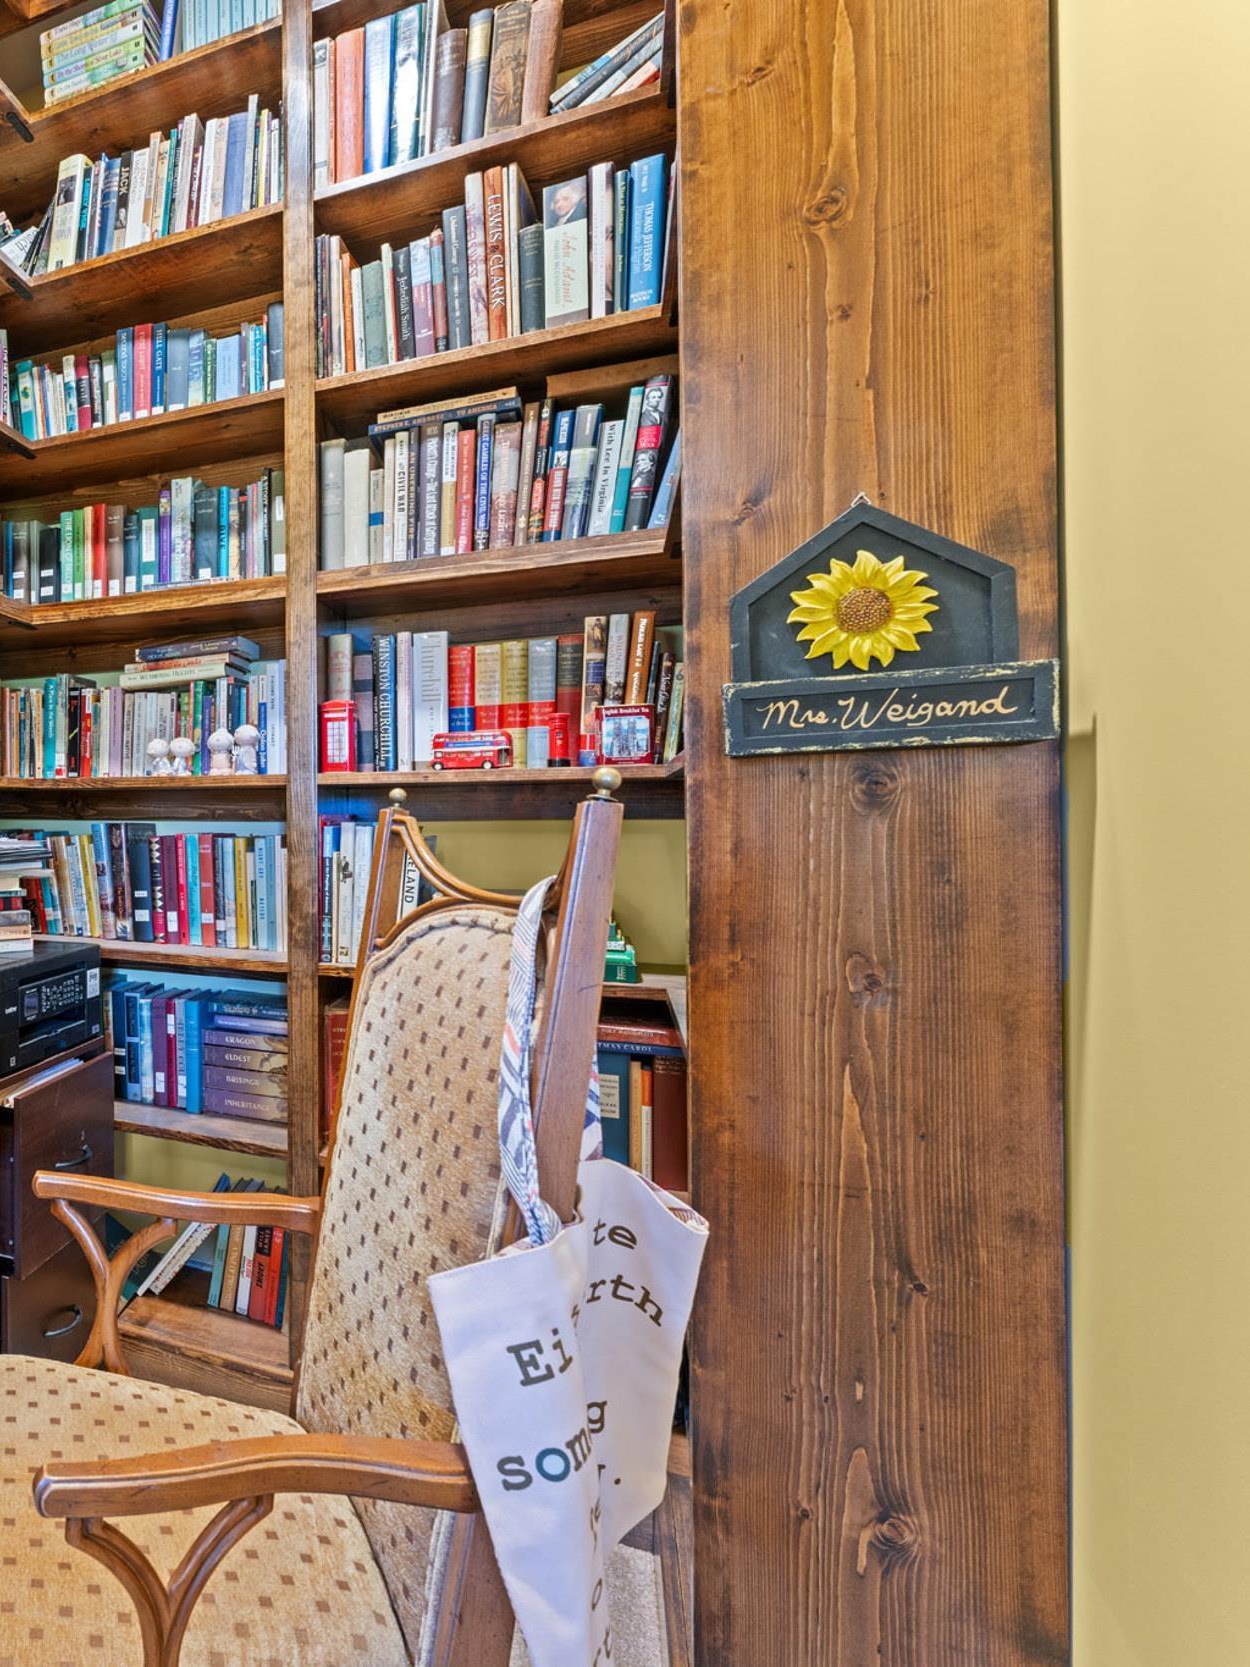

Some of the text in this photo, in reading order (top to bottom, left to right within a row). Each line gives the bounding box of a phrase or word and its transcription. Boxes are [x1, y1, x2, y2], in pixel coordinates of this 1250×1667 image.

[119, 166, 131, 196] JACK
[487, 195, 502, 240] LEWIS
[561, 231, 577, 258] John
[643, 202, 654, 271] THOMAS JEFFERSON
[397, 276, 409, 314] Jedediah
[489, 255, 506, 309] CLARK
[155, 328, 164, 349] HELL
[400, 315, 411, 341] Smith
[155, 350, 163, 372] GATE
[482, 420, 490, 441] GREAT
[397, 471, 406, 492] CIVIL
[481, 472, 488, 481] OF
[596, 423, 617, 512] With Lee In Virginia
[421, 634, 442, 703] Churchill
[379, 637, 392, 761] WINSTON CHURCHILL
[756, 685, 1018, 730] Mrs. Weigand
[259, 752, 267, 768] John
[224, 1036, 256, 1045] ERAGON
[623, 1044, 653, 1052] CAROL
[224, 1054, 251, 1062] ELDEST
[224, 1098, 270, 1111] INHERITANCE
[593, 1220, 638, 1252] te
[585, 1271, 665, 1328] rth
[505, 1327, 572, 1387] Ei
